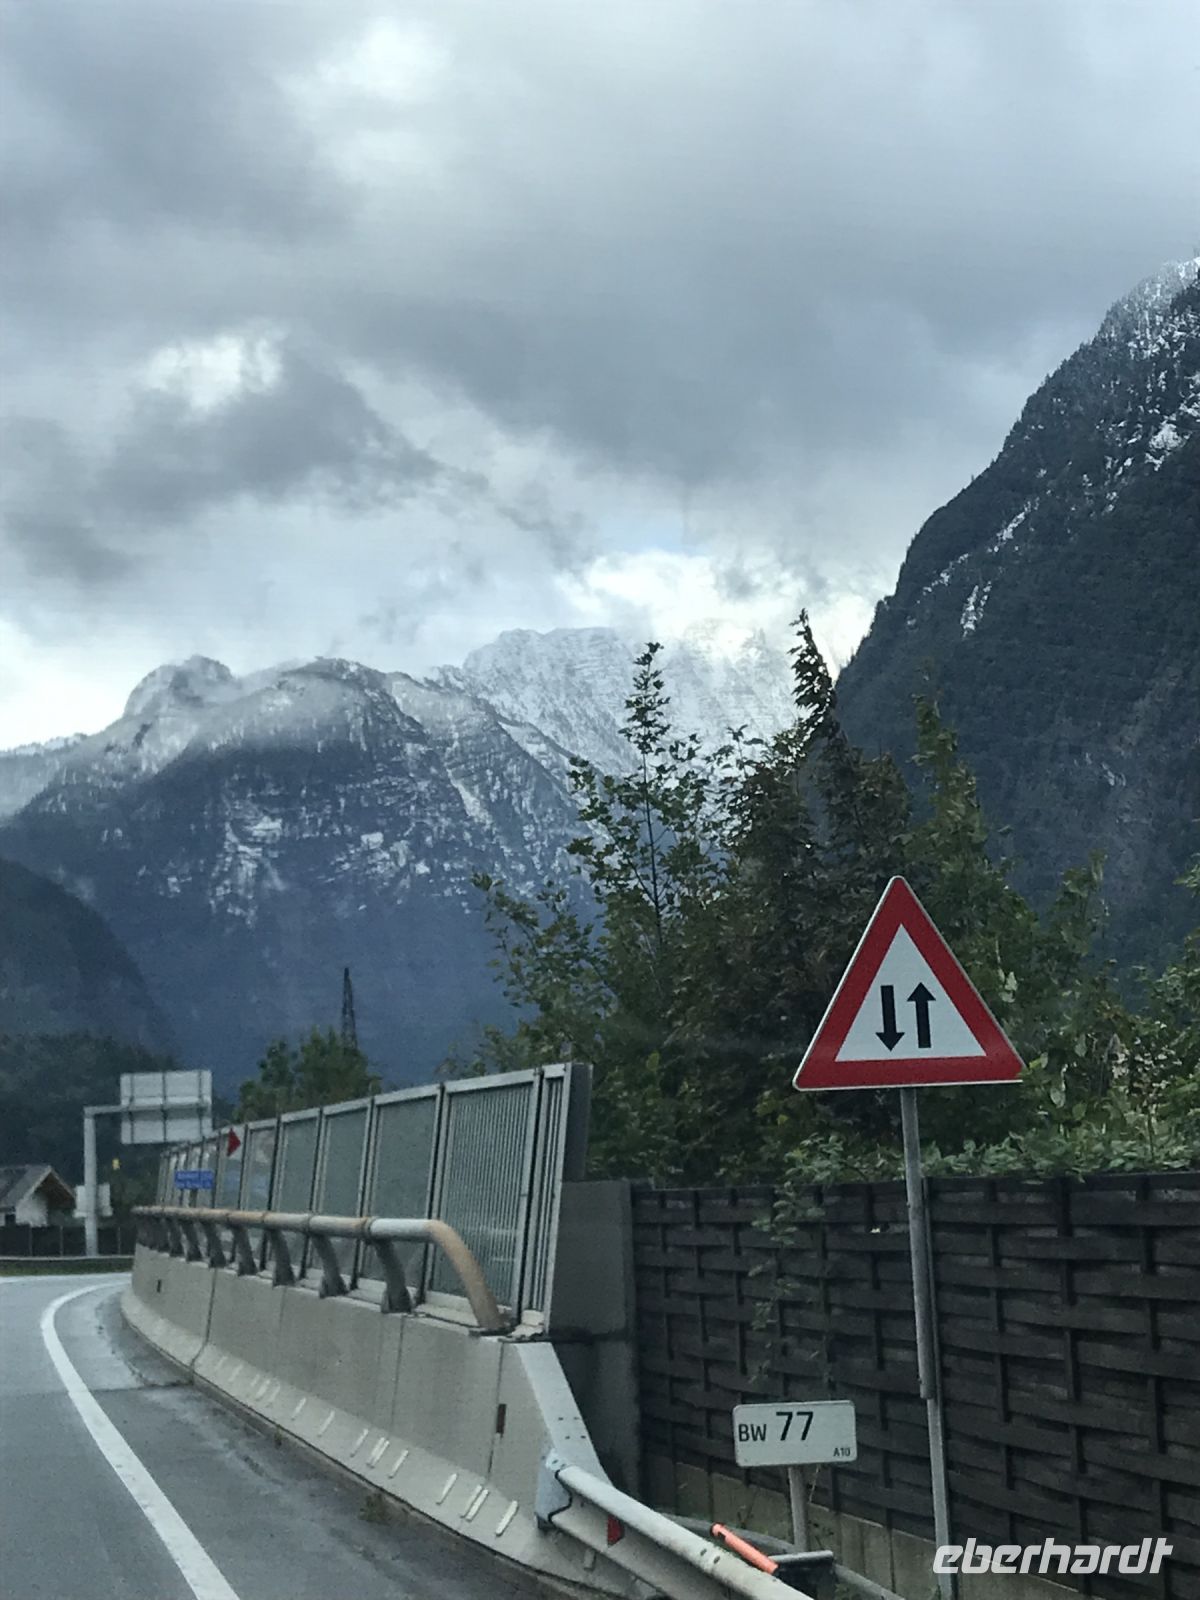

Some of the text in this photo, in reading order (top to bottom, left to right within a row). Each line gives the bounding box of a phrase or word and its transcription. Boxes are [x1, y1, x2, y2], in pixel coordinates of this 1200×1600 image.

[738, 1411, 814, 1442] BW 77
[833, 1447, 851, 1457] A10
